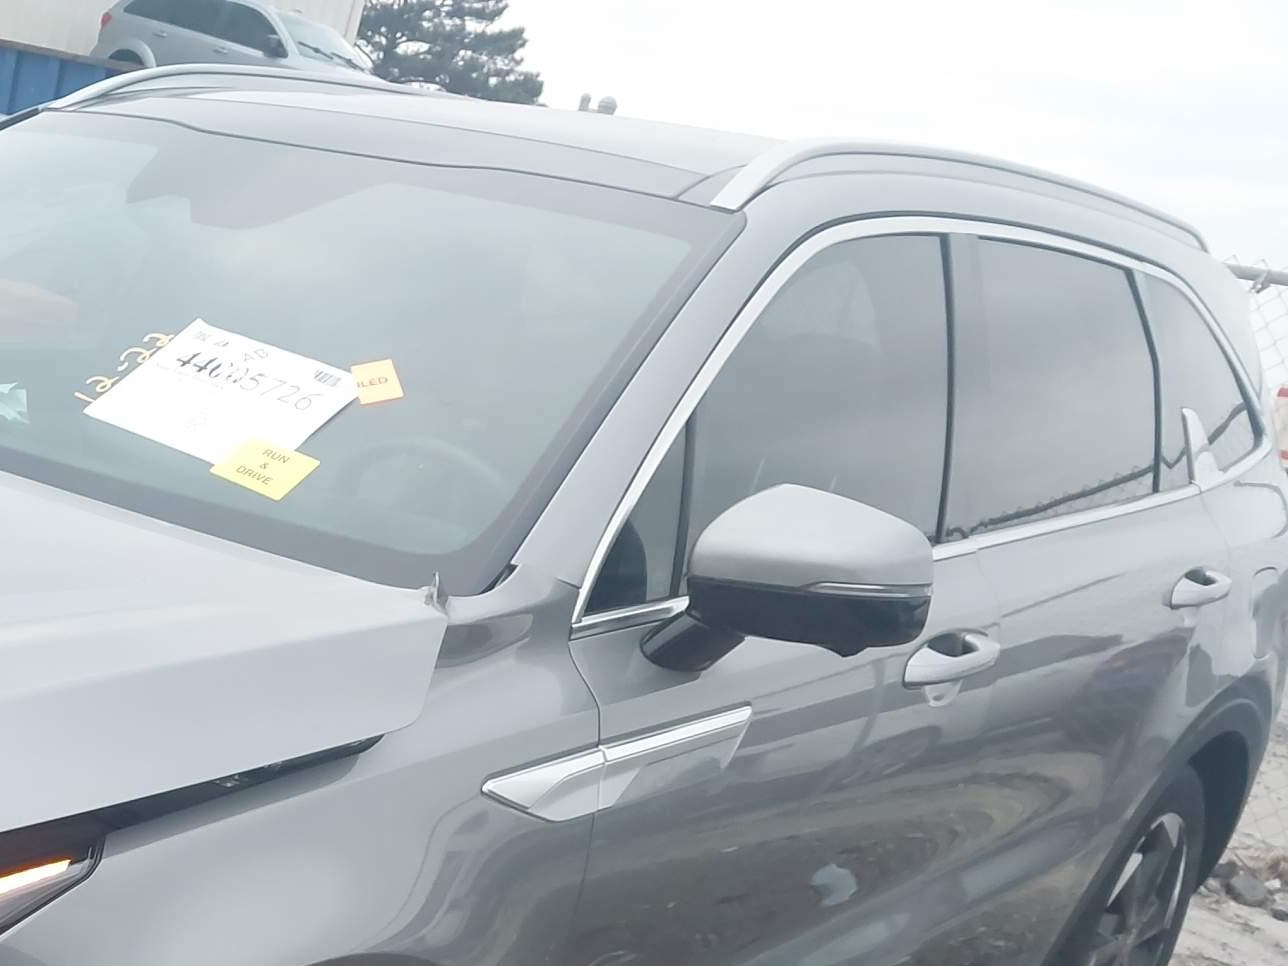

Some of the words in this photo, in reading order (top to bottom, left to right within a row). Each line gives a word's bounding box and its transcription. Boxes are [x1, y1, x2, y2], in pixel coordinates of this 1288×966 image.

[261, 448, 290, 464] RUN
[259, 461, 269, 470] &
[235, 465, 274, 486] DRIVE
